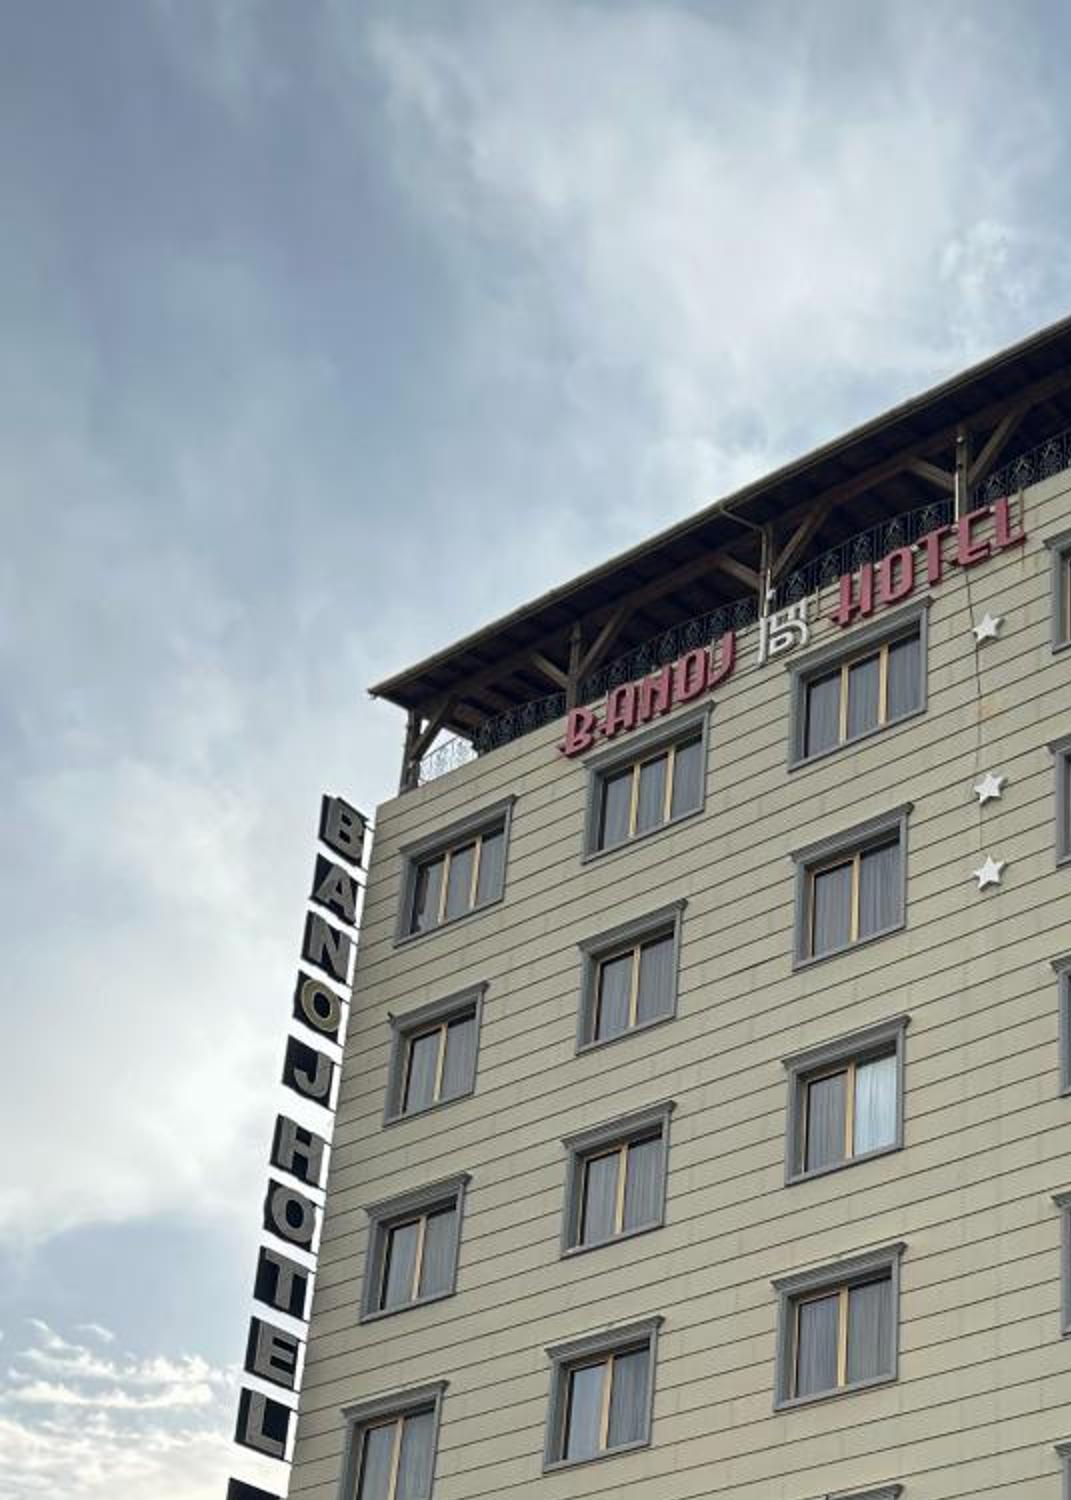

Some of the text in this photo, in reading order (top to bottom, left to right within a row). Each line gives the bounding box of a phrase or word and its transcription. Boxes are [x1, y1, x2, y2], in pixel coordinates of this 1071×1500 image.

[560, 630, 737, 758] BANOJ
[832, 495, 1026, 627] HOTEL
[237, 795, 368, 1461] BANOJ HOTEL
